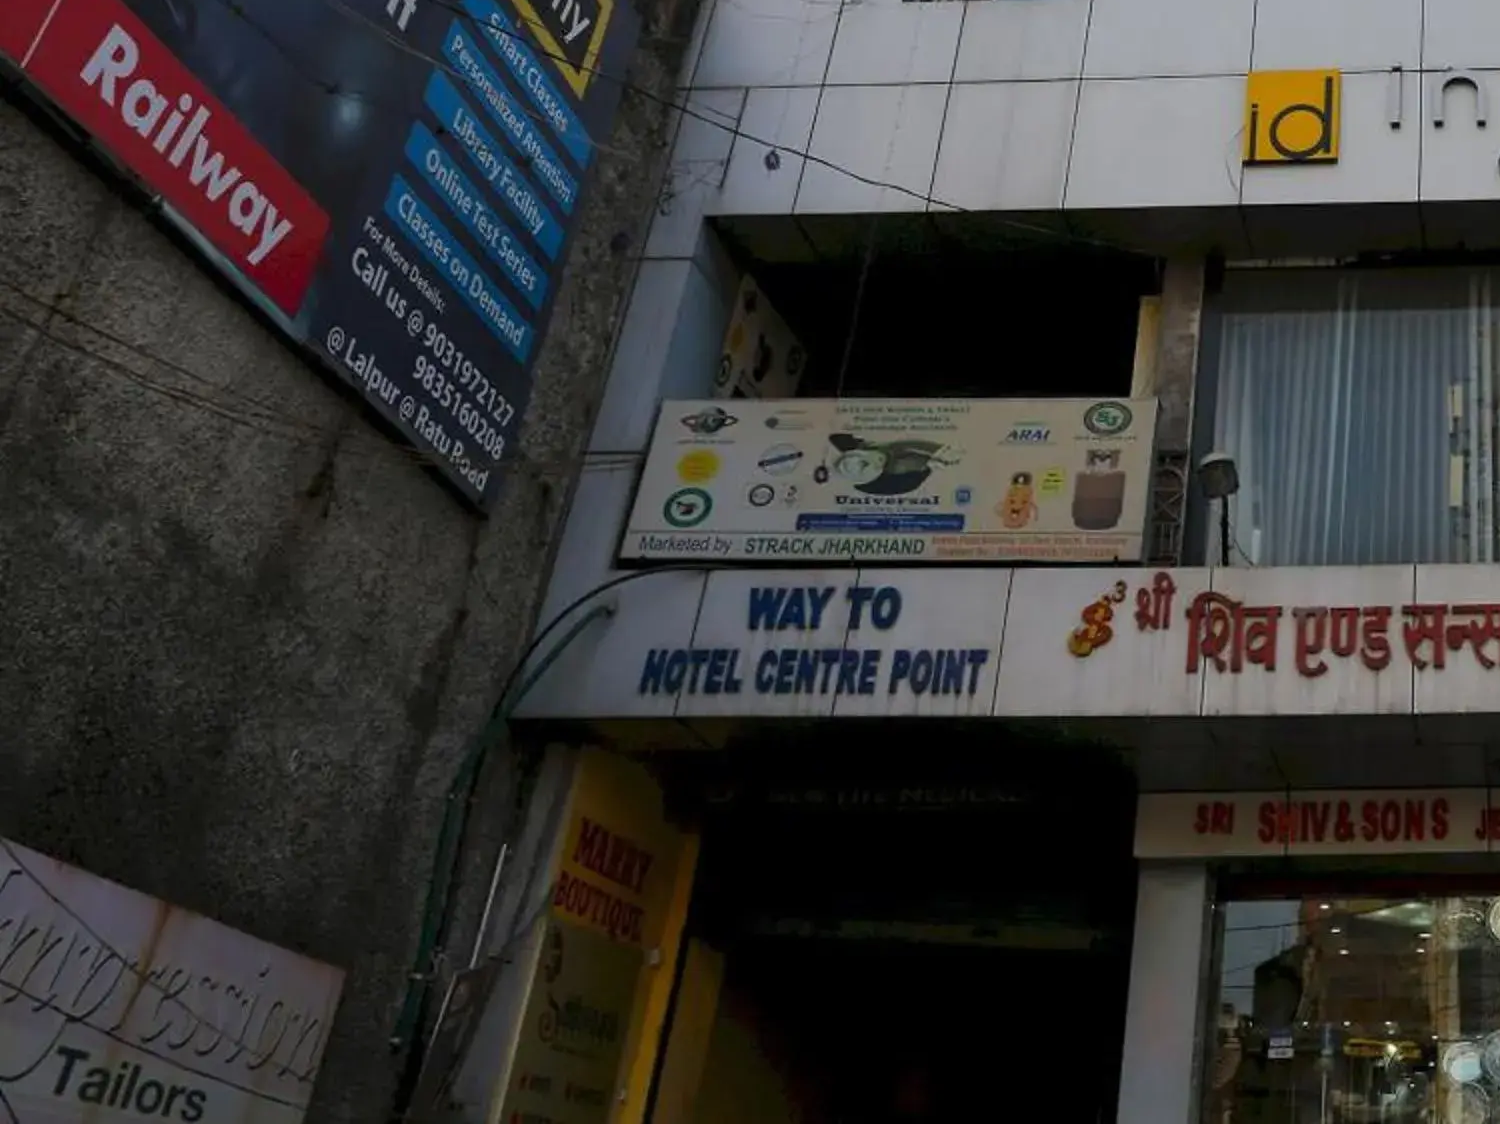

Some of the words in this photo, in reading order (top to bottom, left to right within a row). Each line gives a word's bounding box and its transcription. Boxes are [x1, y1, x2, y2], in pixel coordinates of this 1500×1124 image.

[451, 34, 526, 139] Personalized
[521, 132, 573, 203] Attention
[487, 13, 528, 75] Smart
[527, 67, 569, 132] Classes
[80, 23, 293, 266] Railway
[452, 107, 502, 181] Library
[499, 166, 546, 236] Facility
[361, 216, 383, 245] For
[397, 194, 451, 266] Classes
[449, 257, 471, 287] on
[467, 274, 526, 347] Demand
[425, 148, 477, 218] Online
[469, 200, 501, 248] Test
[497, 235, 538, 292] Series
[351, 246, 388, 298] Call
[385, 286, 408, 320] us
[407, 309, 425, 337] @
[423, 323, 515, 428] 9031972127
[326, 326, 345, 355] @
[344, 337, 401, 406] Lalpur
[399, 394, 416, 421] @
[413, 405, 452, 456] Ratu
[412, 354, 506, 461] 9835160208
[638, 534, 711, 553] Marketed
[714, 535, 733, 557] by
[743, 537, 816, 556] STRACK
[816, 537, 926, 557] JHARKHAND
[835, 494, 941, 507] Universal
[746, 587, 835, 631] WAY
[846, 587, 902, 631] TO
[1134, 572, 1176, 631] श्री
[1185, 591, 1282, 674] शिव
[638, 648, 743, 695] HOTEL
[755, 649, 886, 696] CENTRE
[888, 648, 990, 696] POINT
[1194, 804, 1235, 835] SRI
[52, 1044, 207, 1124] Tailors
